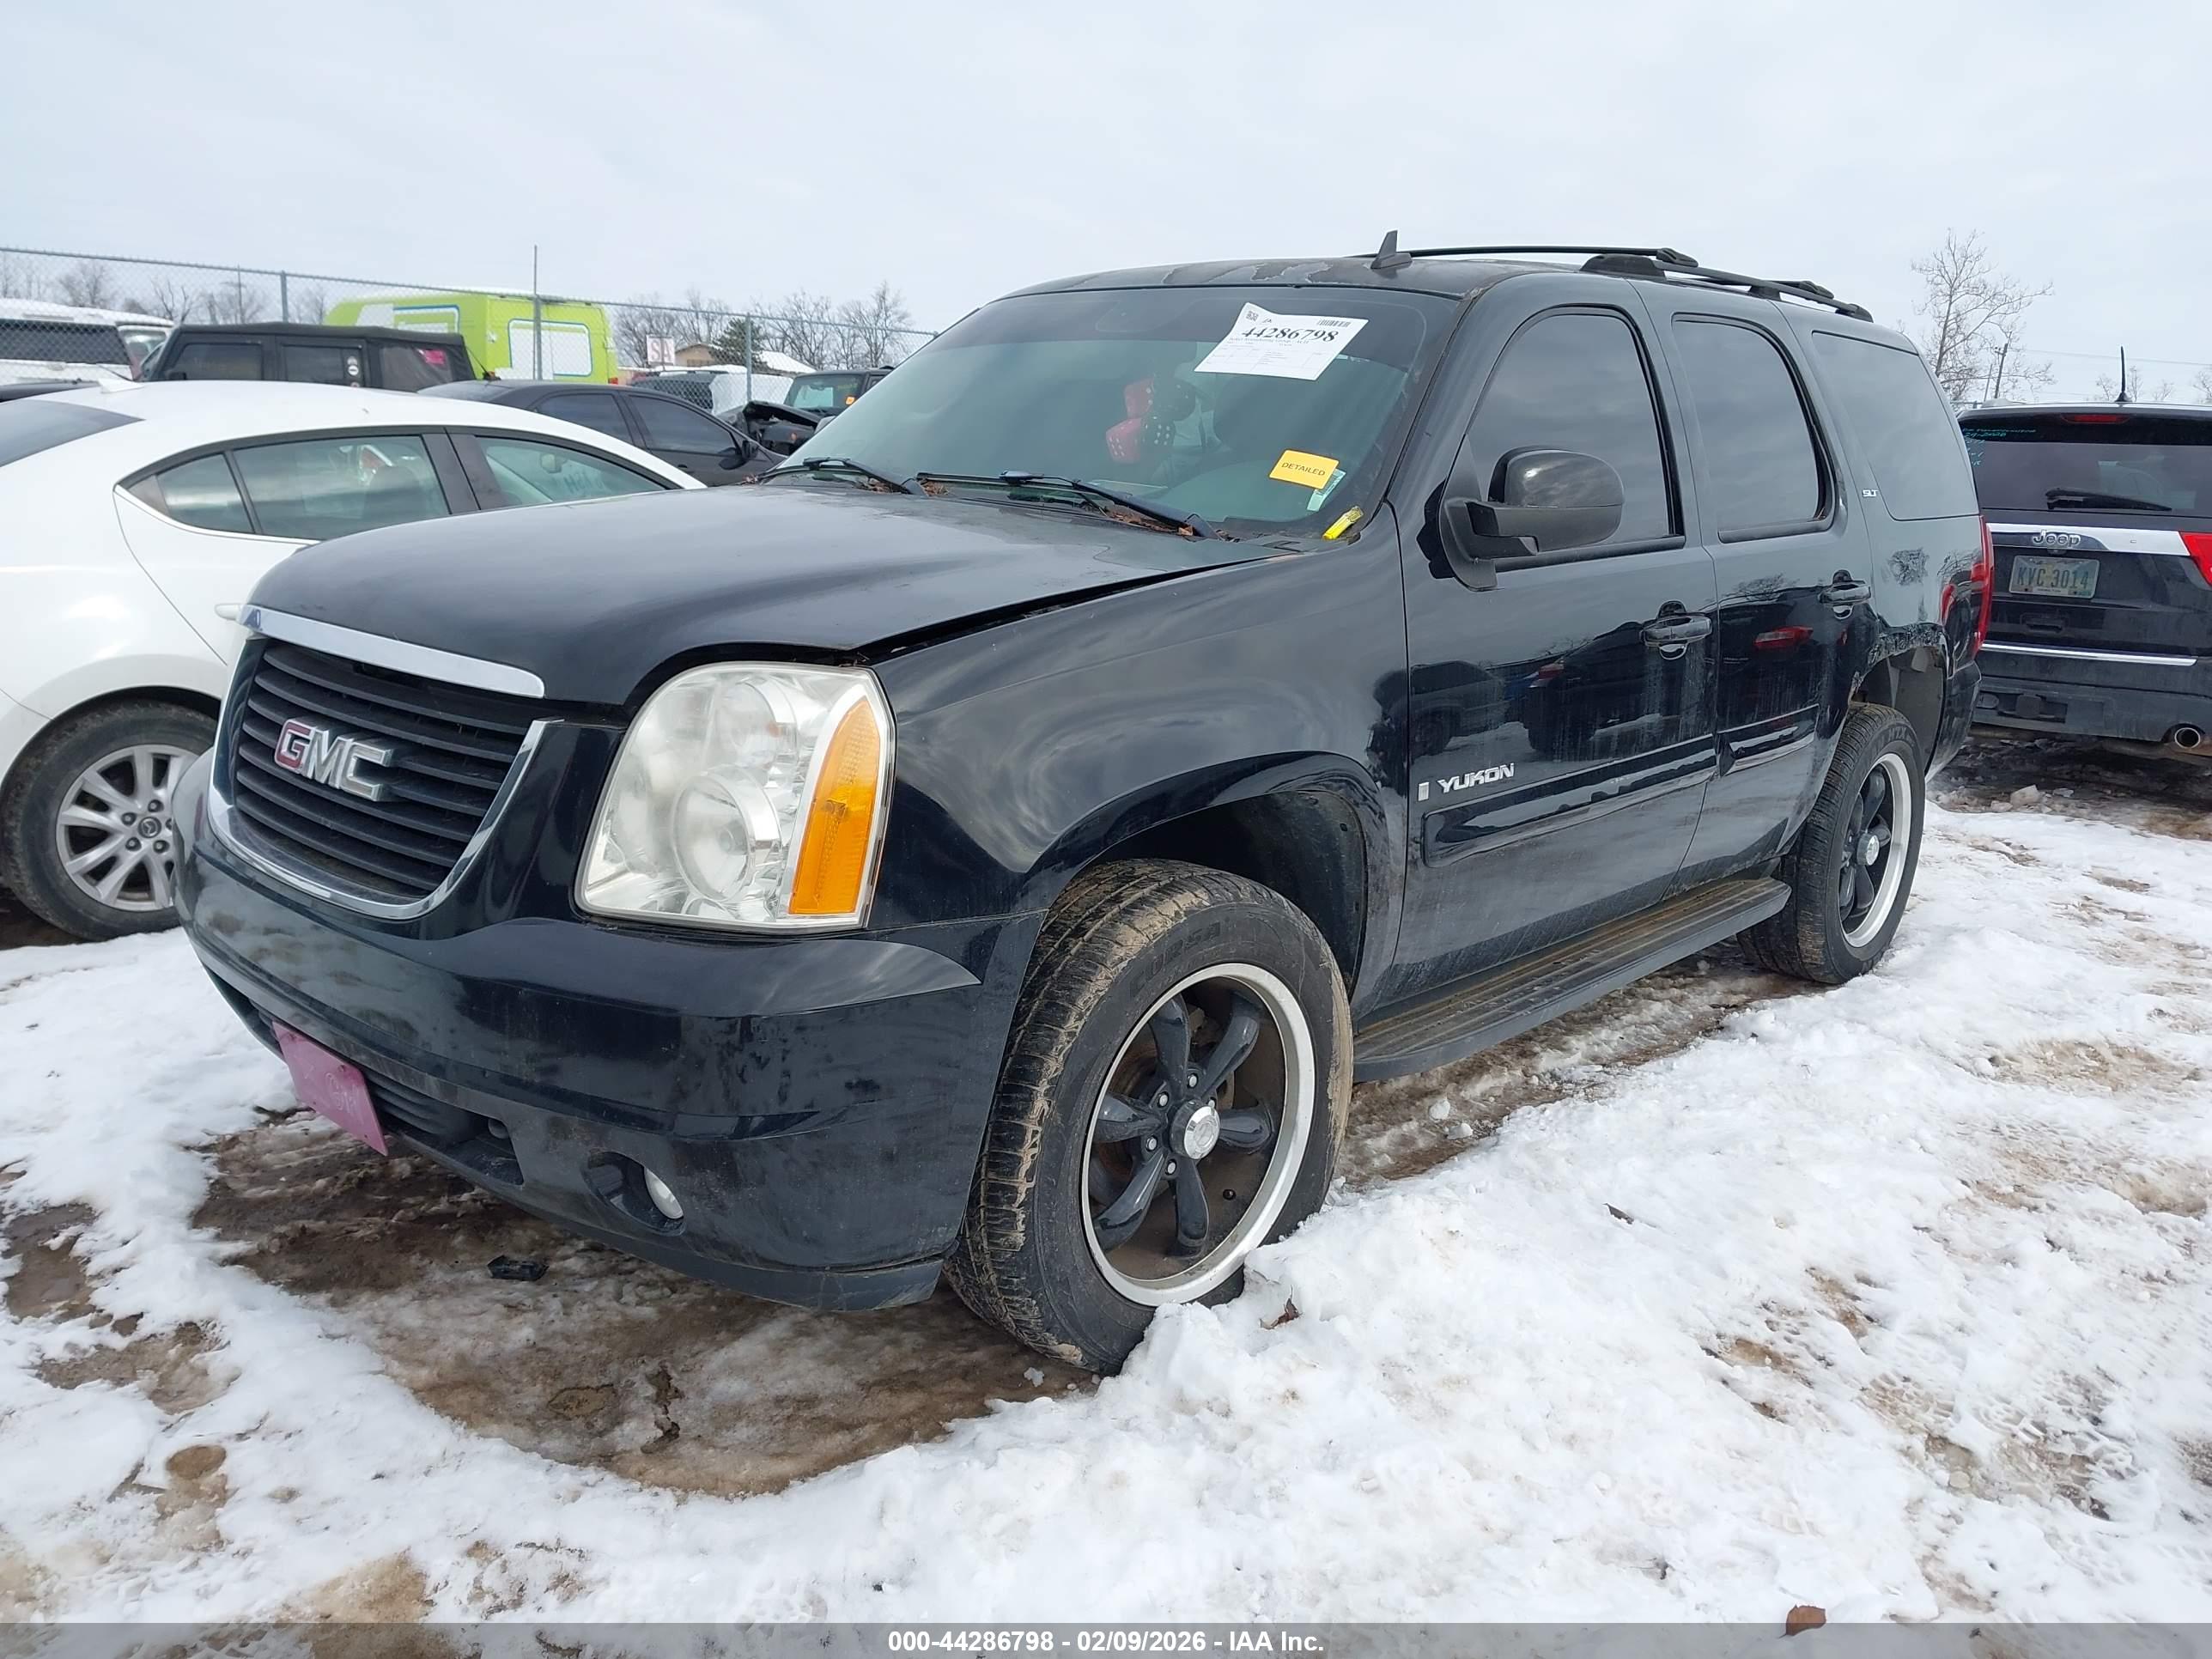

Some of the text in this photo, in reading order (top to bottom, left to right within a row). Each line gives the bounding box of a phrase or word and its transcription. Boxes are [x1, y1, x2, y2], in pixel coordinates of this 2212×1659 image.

[1242, 326, 1339, 343] 44286798
[1281, 462, 1326, 477] DETAILED
[2032, 530, 2081, 549] Jeep
[2050, 568, 2090, 590] 3014
[274, 720, 394, 802] GMC
[1437, 763, 1515, 793] YUKON
